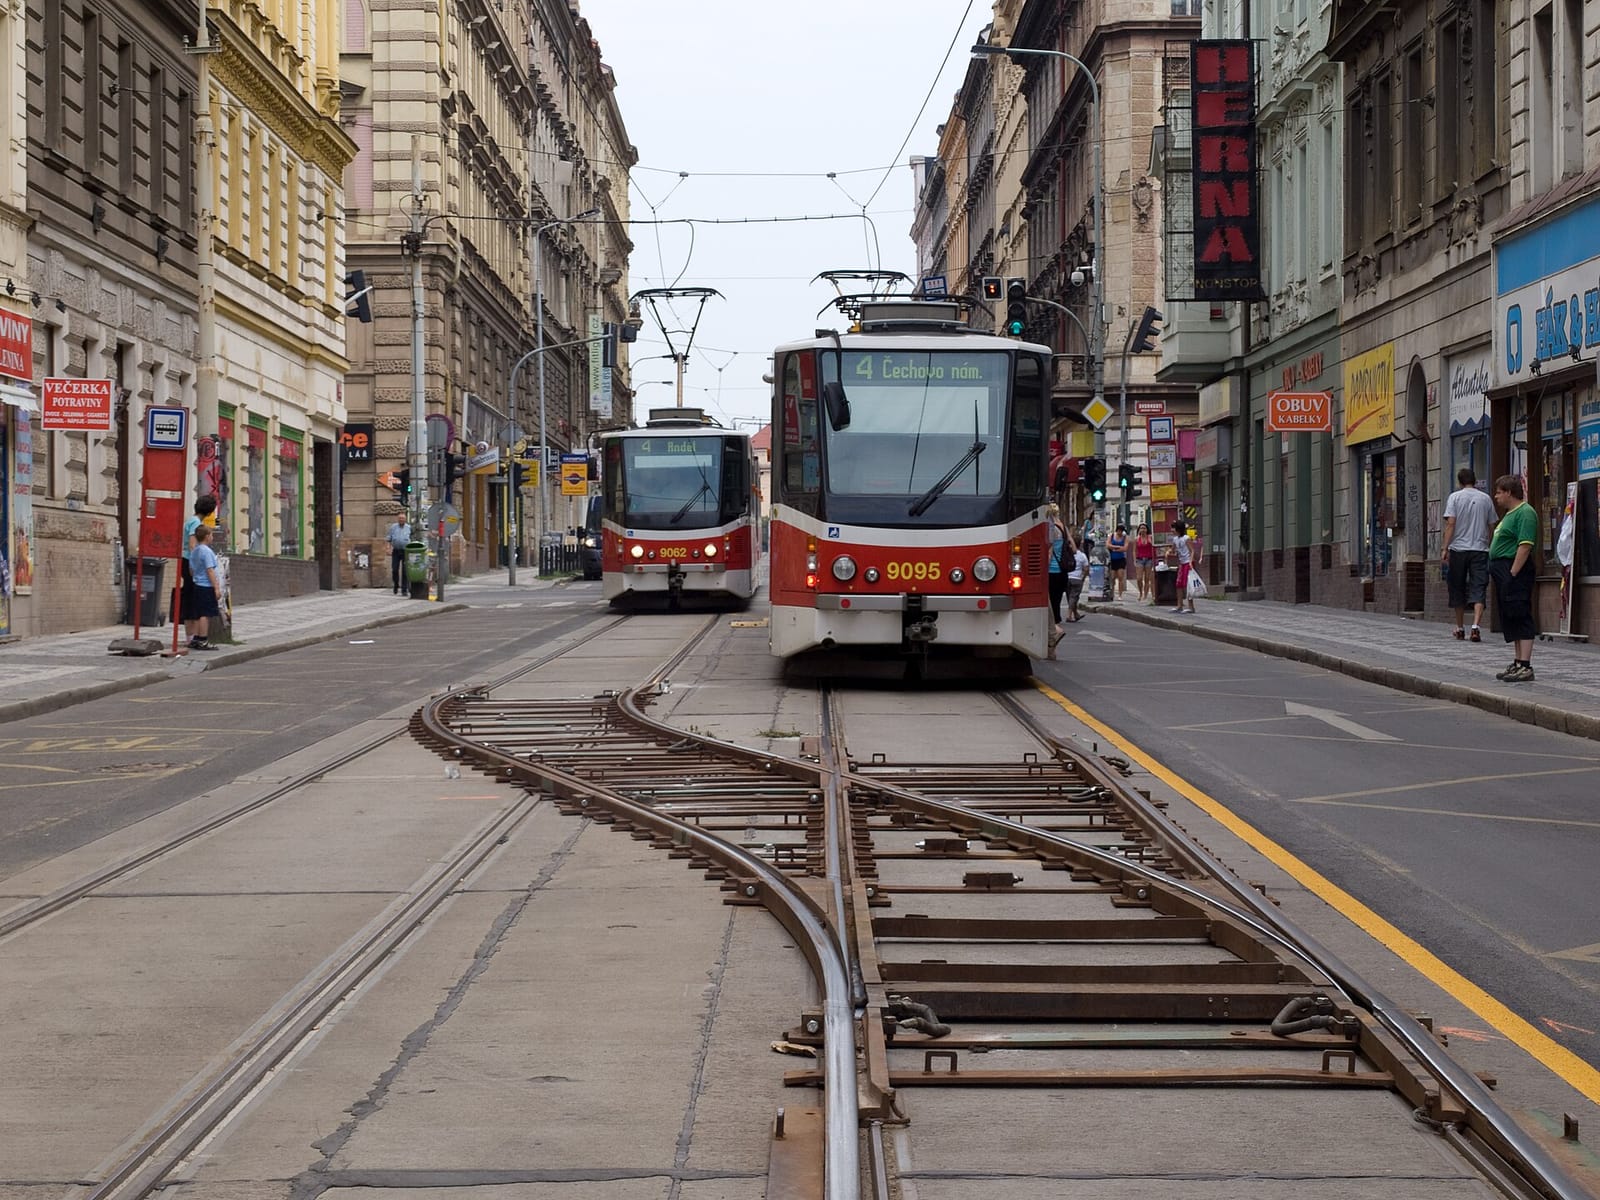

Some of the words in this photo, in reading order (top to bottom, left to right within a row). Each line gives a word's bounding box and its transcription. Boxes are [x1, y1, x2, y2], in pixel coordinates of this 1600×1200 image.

[1196, 47, 1254, 263] HERNA
[1195, 278, 1257, 289] NONSTOP
[1536, 285, 1569, 362] HÁK
[1570, 294, 1583, 350] &
[855, 355, 873, 380] 4
[882, 355, 945, 380] Čechovo
[951, 361, 984, 380] nám.
[45, 380, 109, 395] VEČERKA
[52, 397, 103, 408] POTRAVINY
[1276, 398, 1324, 412] OBUV
[1278, 415, 1323, 424] KABELKY
[641, 440, 651, 453] 4
[659, 547, 687, 558] 9062
[886, 561, 941, 580] 9095
